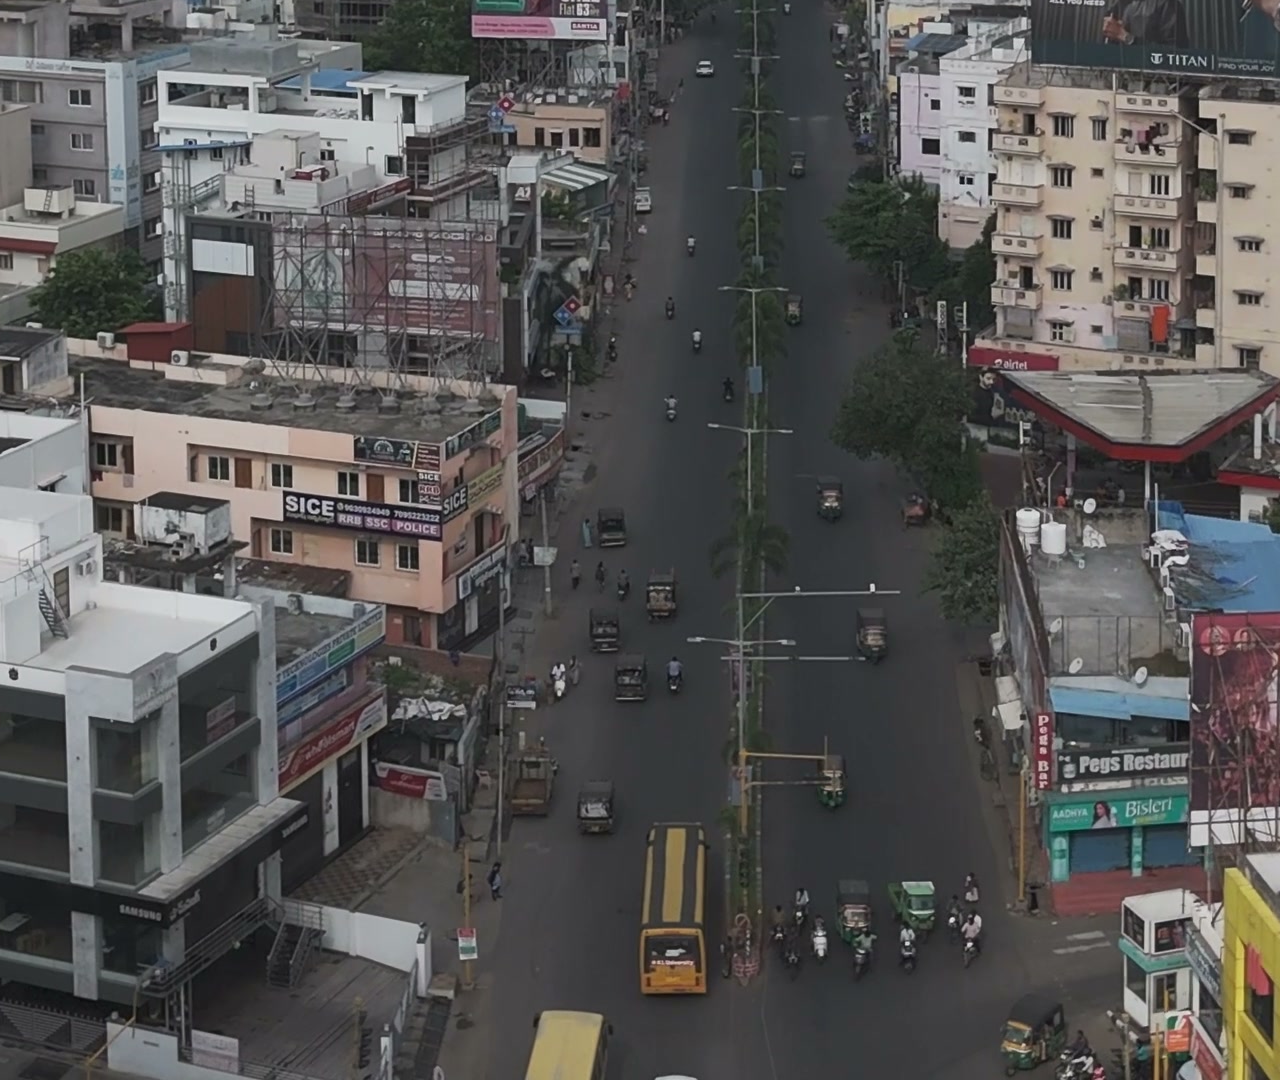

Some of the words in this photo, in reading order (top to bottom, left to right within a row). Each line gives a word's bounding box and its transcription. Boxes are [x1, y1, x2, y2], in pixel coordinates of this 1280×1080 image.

[1167, 54, 1208, 67] TITAN
[1218, 63, 1236, 71] FIND
[1238, 64, 1260, 72] YOUR
[1003, 359, 1028, 370] airtel
[418, 473, 440, 482] SICE
[420, 486, 440, 494] RRB
[285, 496, 334, 516] SICE
[443, 488, 467, 514] SICE
[338, 514, 362, 526] RRB
[366, 518, 388, 529] SSC
[396, 522, 438, 534] POLICE
[332, 626, 358, 647] PRIVATE
[358, 609, 384, 632] LIMITED
[1038, 716, 1050, 755] Pegs
[1080, 756, 1120, 774] Pegs
[1124, 752, 1189, 772] Restaur
[1038, 760, 1049, 789] Bar
[1052, 808, 1088, 819] AADHYA
[1126, 798, 1172, 818] Bisleri
[120, 904, 162, 922] SAMSUNG
